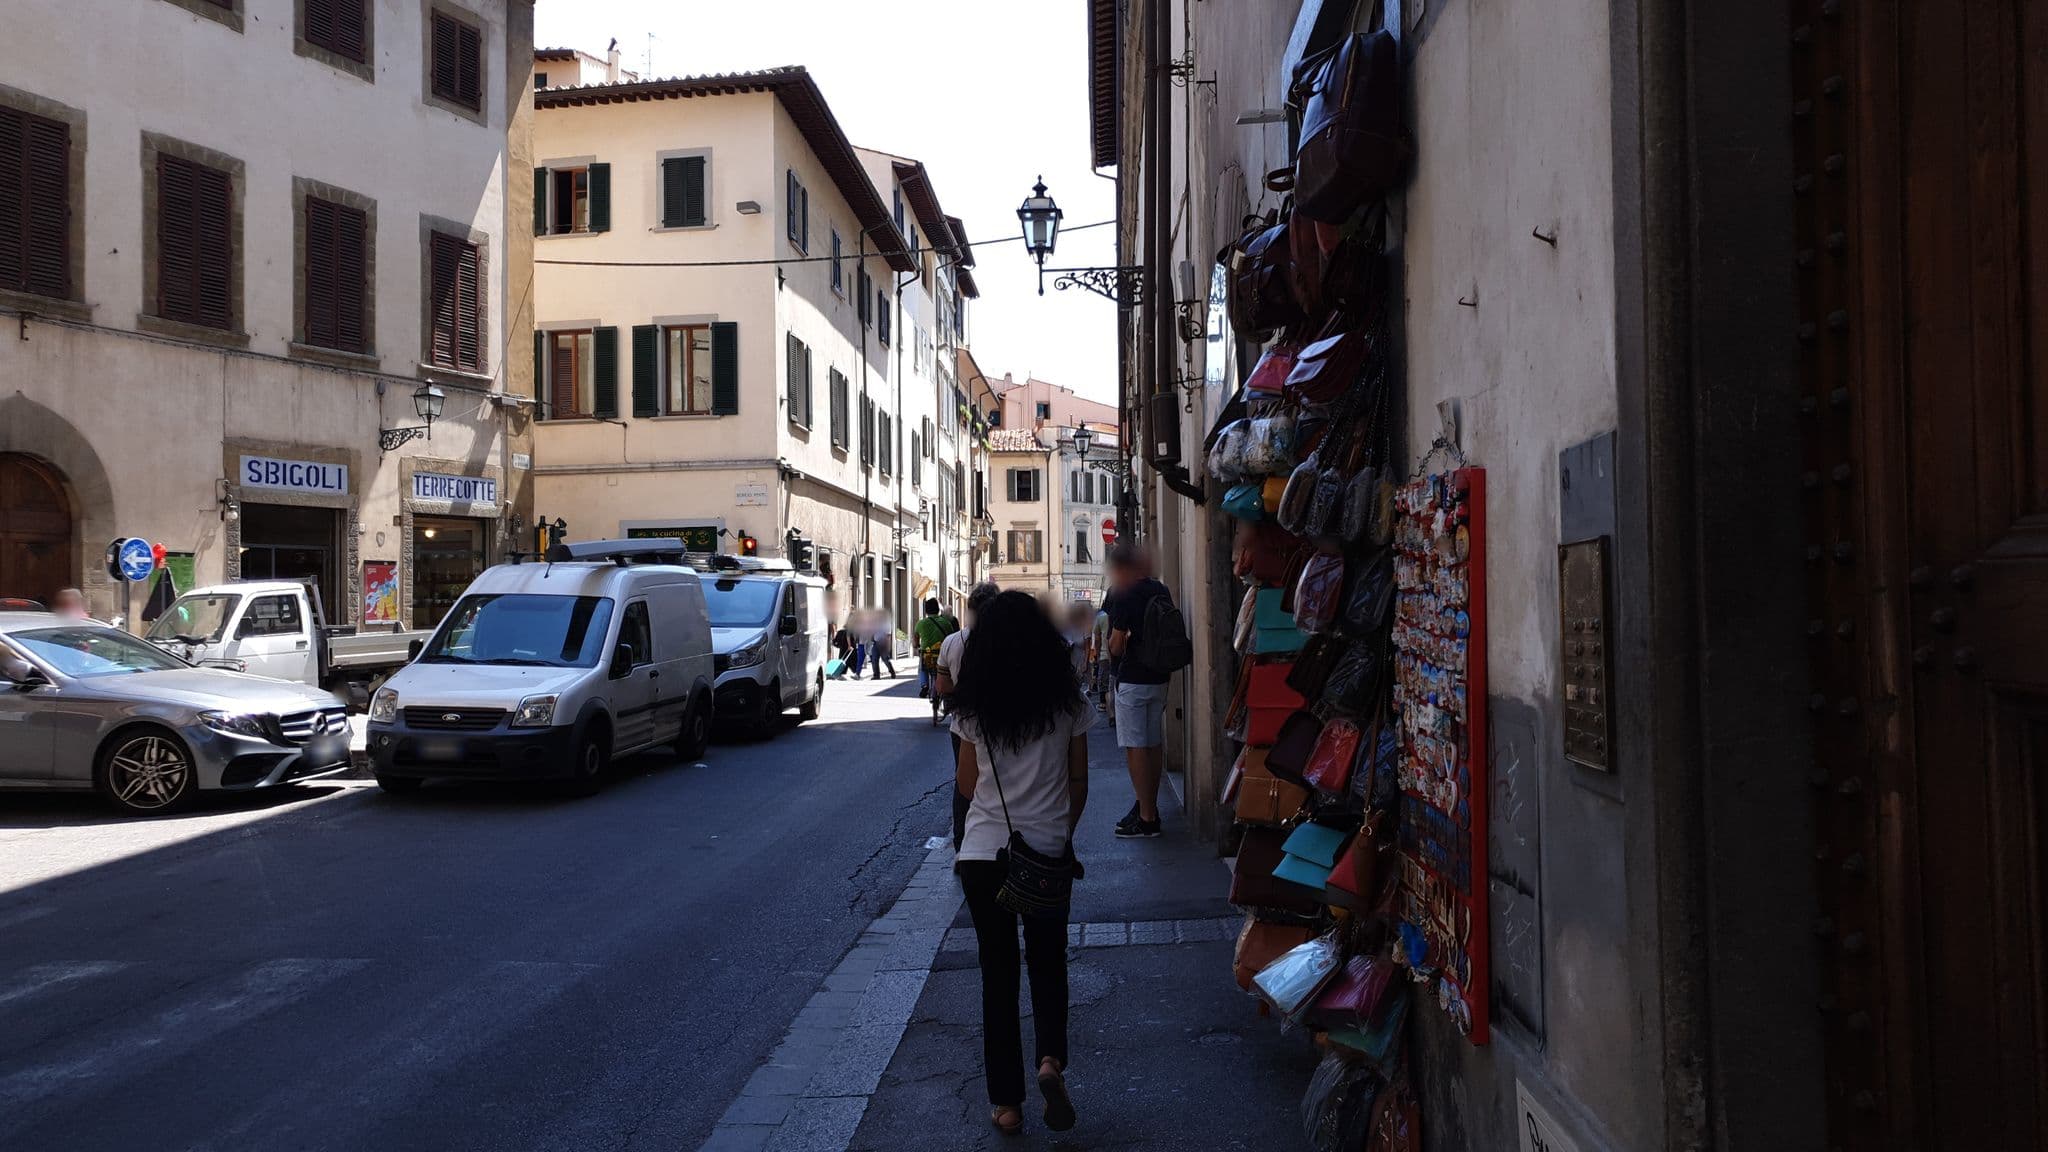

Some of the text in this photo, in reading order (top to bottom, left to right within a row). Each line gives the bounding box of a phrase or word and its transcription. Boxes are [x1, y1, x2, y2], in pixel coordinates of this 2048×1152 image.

[247, 459, 343, 490] SBIGOLI
[413, 474, 495, 502] TERRECOTTE
[660, 529, 685, 537] cucina
